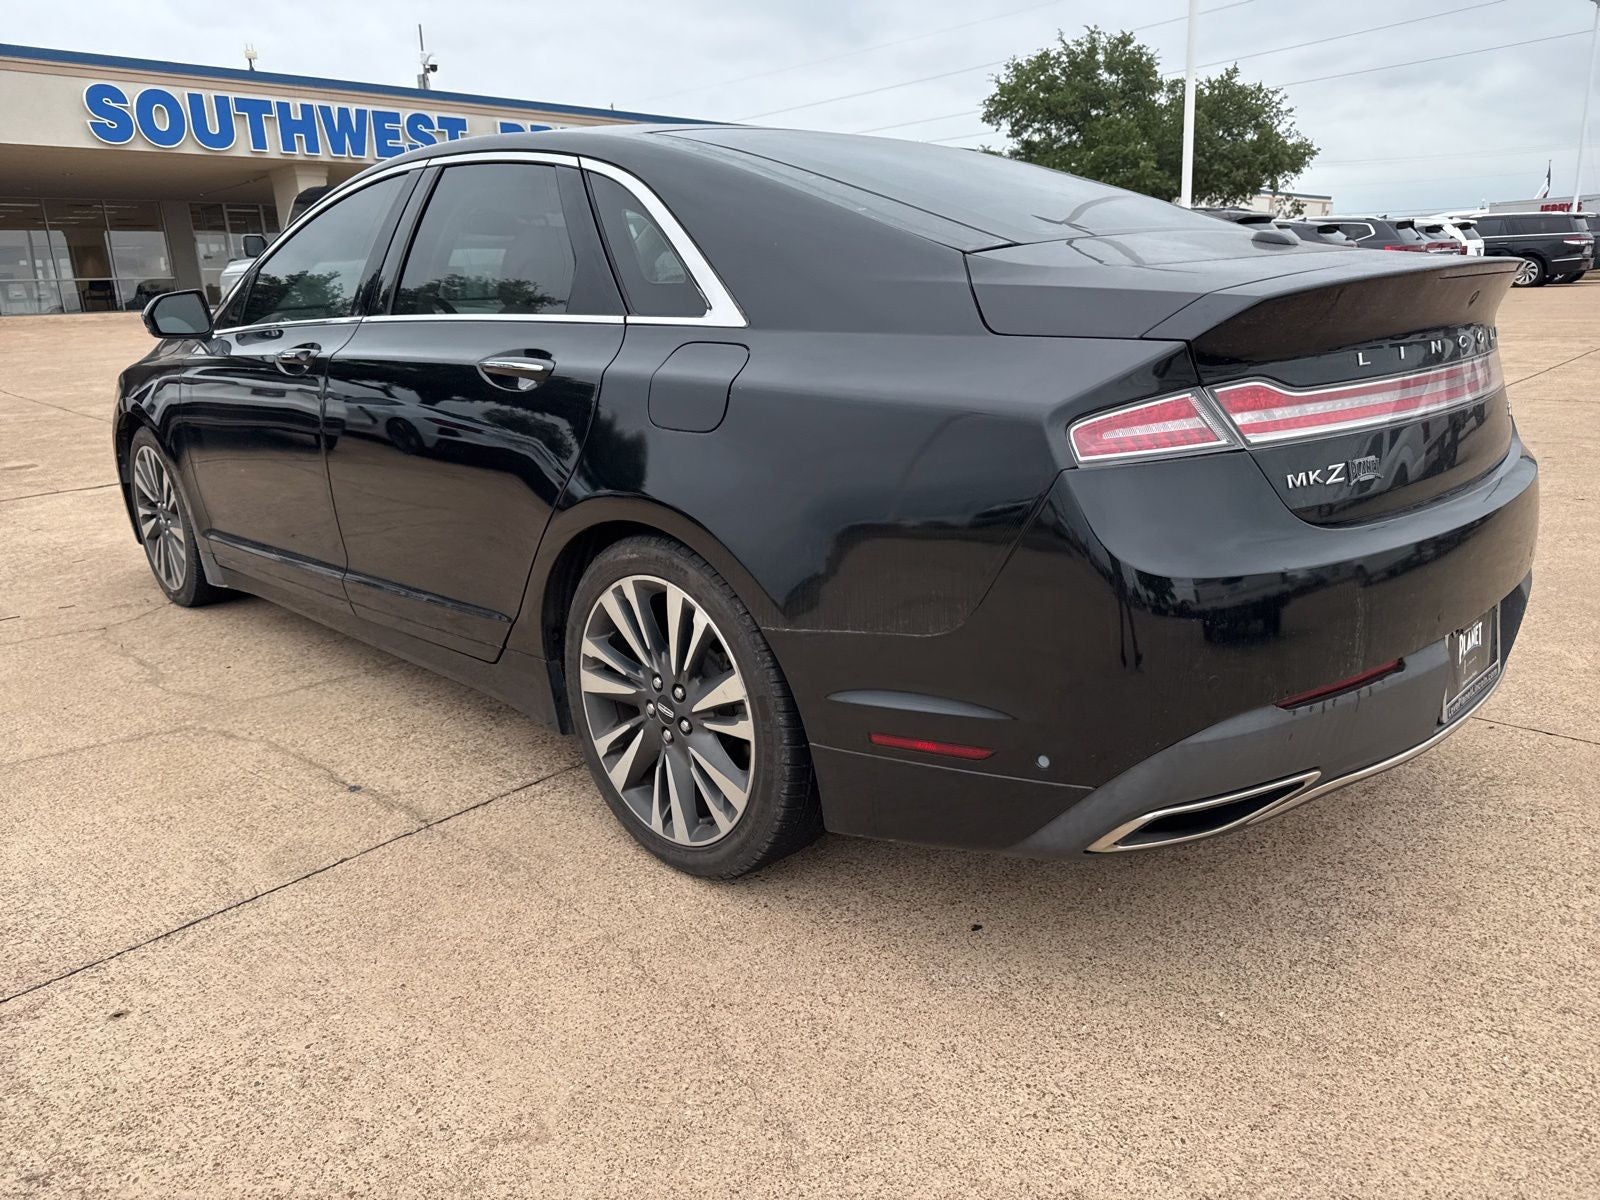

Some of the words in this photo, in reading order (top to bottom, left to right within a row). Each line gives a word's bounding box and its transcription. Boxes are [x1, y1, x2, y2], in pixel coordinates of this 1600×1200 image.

[84, 83, 468, 159] SOUTHWEST
[1357, 327, 1496, 366] LINCOL
[1459, 621, 1483, 665] PLANET
